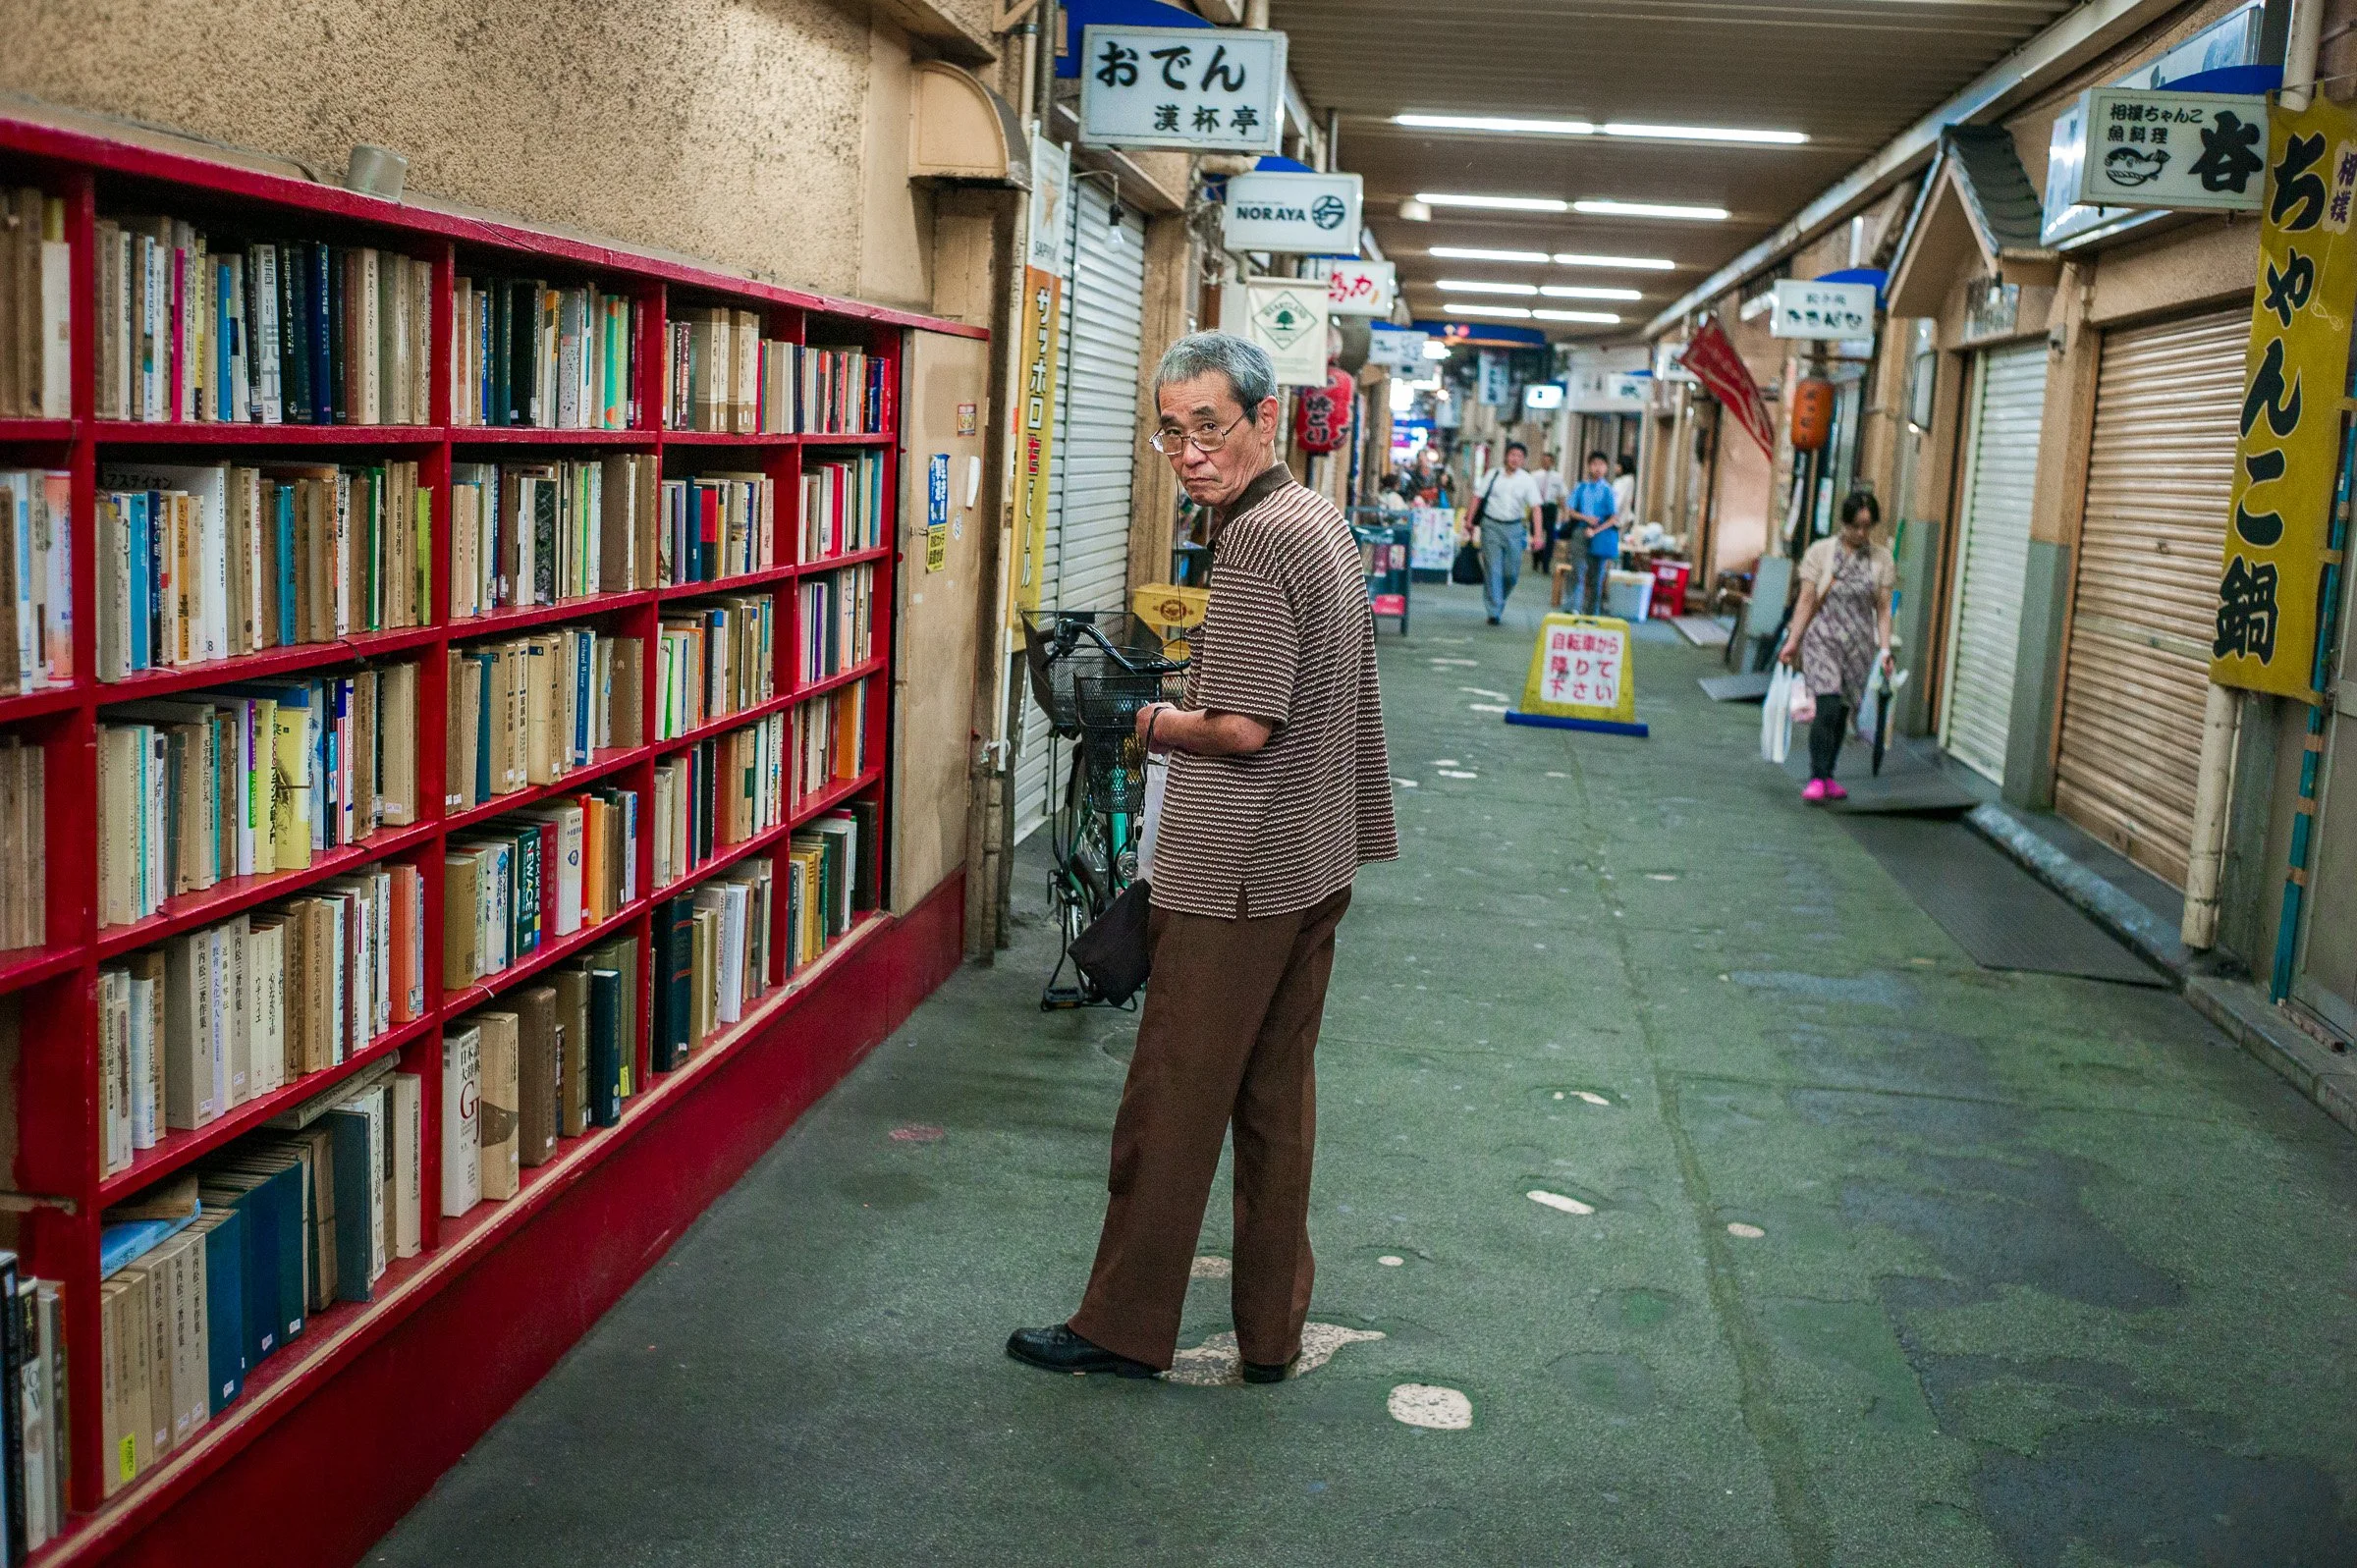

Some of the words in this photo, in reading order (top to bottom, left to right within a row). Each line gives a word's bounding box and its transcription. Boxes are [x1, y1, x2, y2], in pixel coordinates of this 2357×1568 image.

[1096, 41, 1245, 92] おでん
[2110, 103, 2204, 124] 相撲ちゃんこ
[2108, 127, 2168, 144] 魚料理
[2187, 110, 2264, 193] 谷
[2330, 152, 2357, 223] 相撲
[1236, 205, 1306, 221] NORAYA
[2212, 131, 2327, 662] ちゃんこ鍋
[1552, 632, 1619, 655] 自転車から
[1551, 656, 1614, 678] 降りて
[1550, 678, 1613, 701] 下さい
[461, 1043, 480, 1066] 日本語
